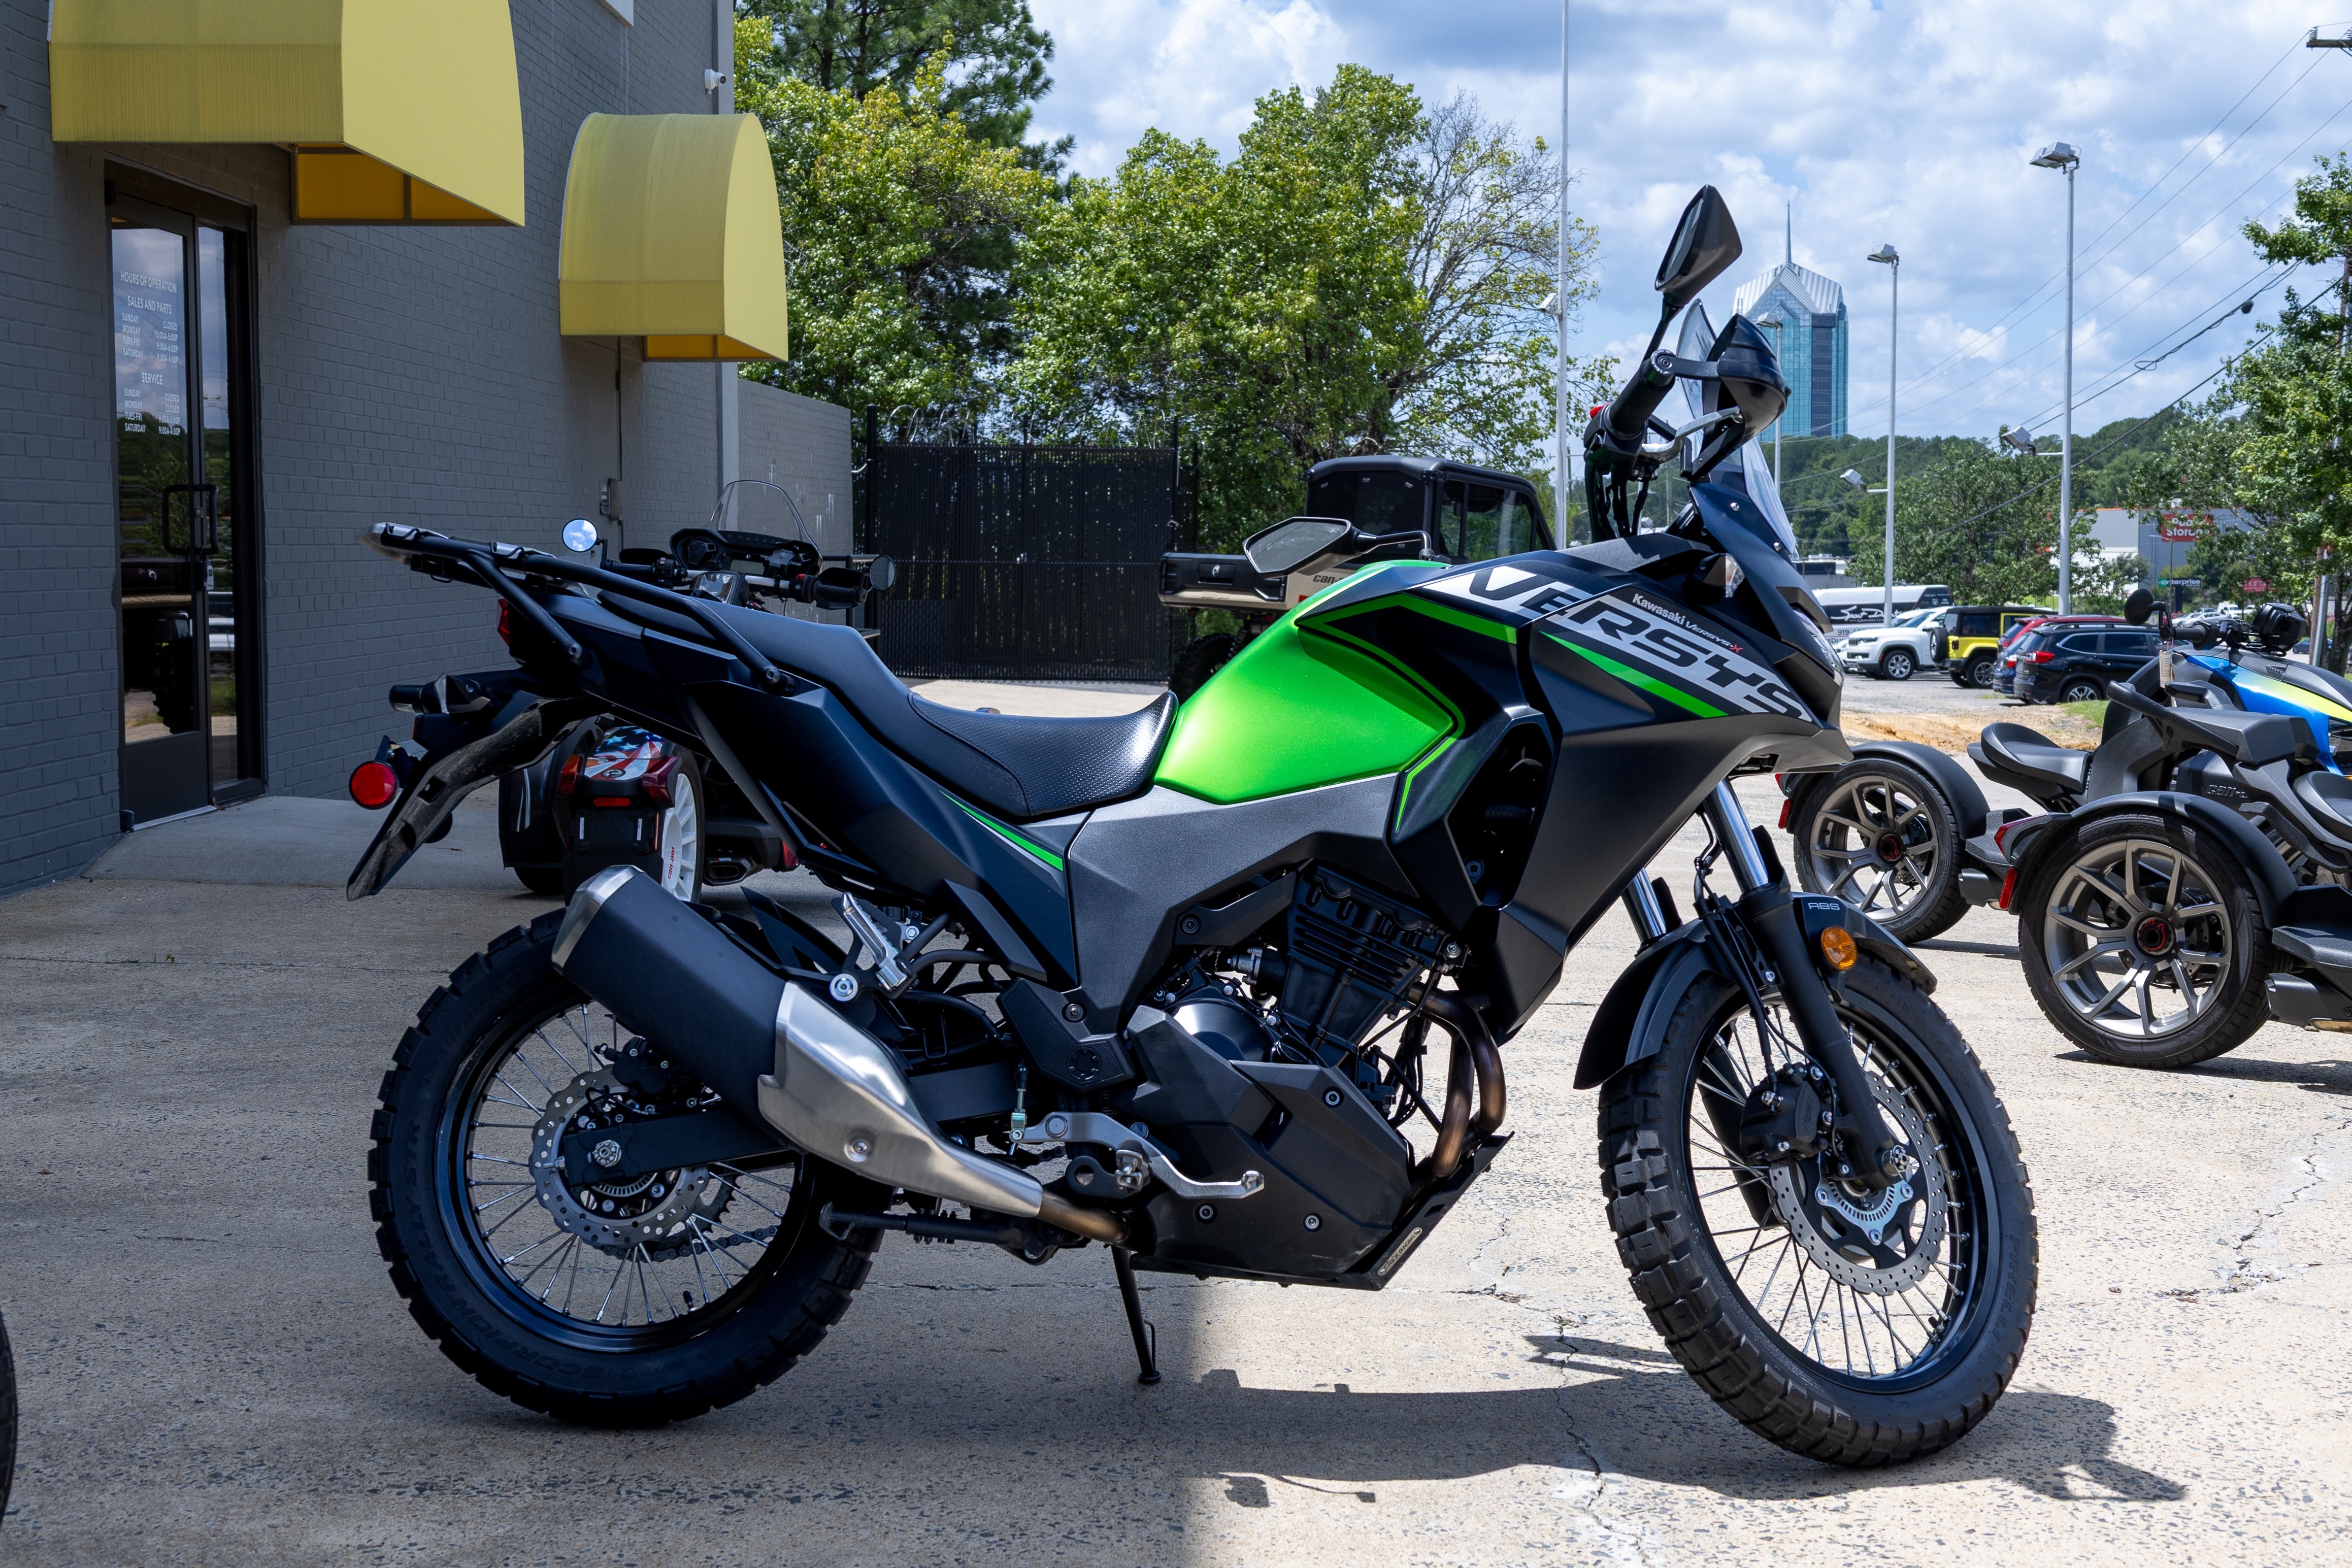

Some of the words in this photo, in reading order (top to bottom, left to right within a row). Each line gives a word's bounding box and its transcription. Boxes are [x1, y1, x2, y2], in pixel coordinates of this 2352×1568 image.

[120, 271, 139, 285] HOURS
[140, 276, 147, 286] OF
[148, 277, 177, 293] OPERATION
[127, 295, 143, 309] SALES
[144, 299, 156, 311] AND
[156, 302, 172, 314] PARTS
[122, 312, 138, 323] SUNDAY
[122, 324, 141, 335] MONDAY
[162, 320, 178, 330] CLOSED
[122, 336, 140, 346] TUES-FRI
[123, 348, 144, 358] SATURDAY
[142, 372, 163, 385] SERVICE
[124, 388, 141, 397] SUNDAY
[165, 393, 180, 402] CLOSED
[124, 399, 143, 409] MONDAY
[165, 405, 180, 413] CLOSED
[124, 412, 142, 421] TUES-FRI
[125, 423, 146, 432] SATURDAY
[1632, 593, 1685, 625] Kawasaki
[2074, 829, 2107, 850] KENDA
[1383, 1253, 1400, 1270] T-REX
[1399, 1235, 1415, 1254] RACING
[1992, 1232, 2021, 1343] PIRELLI
